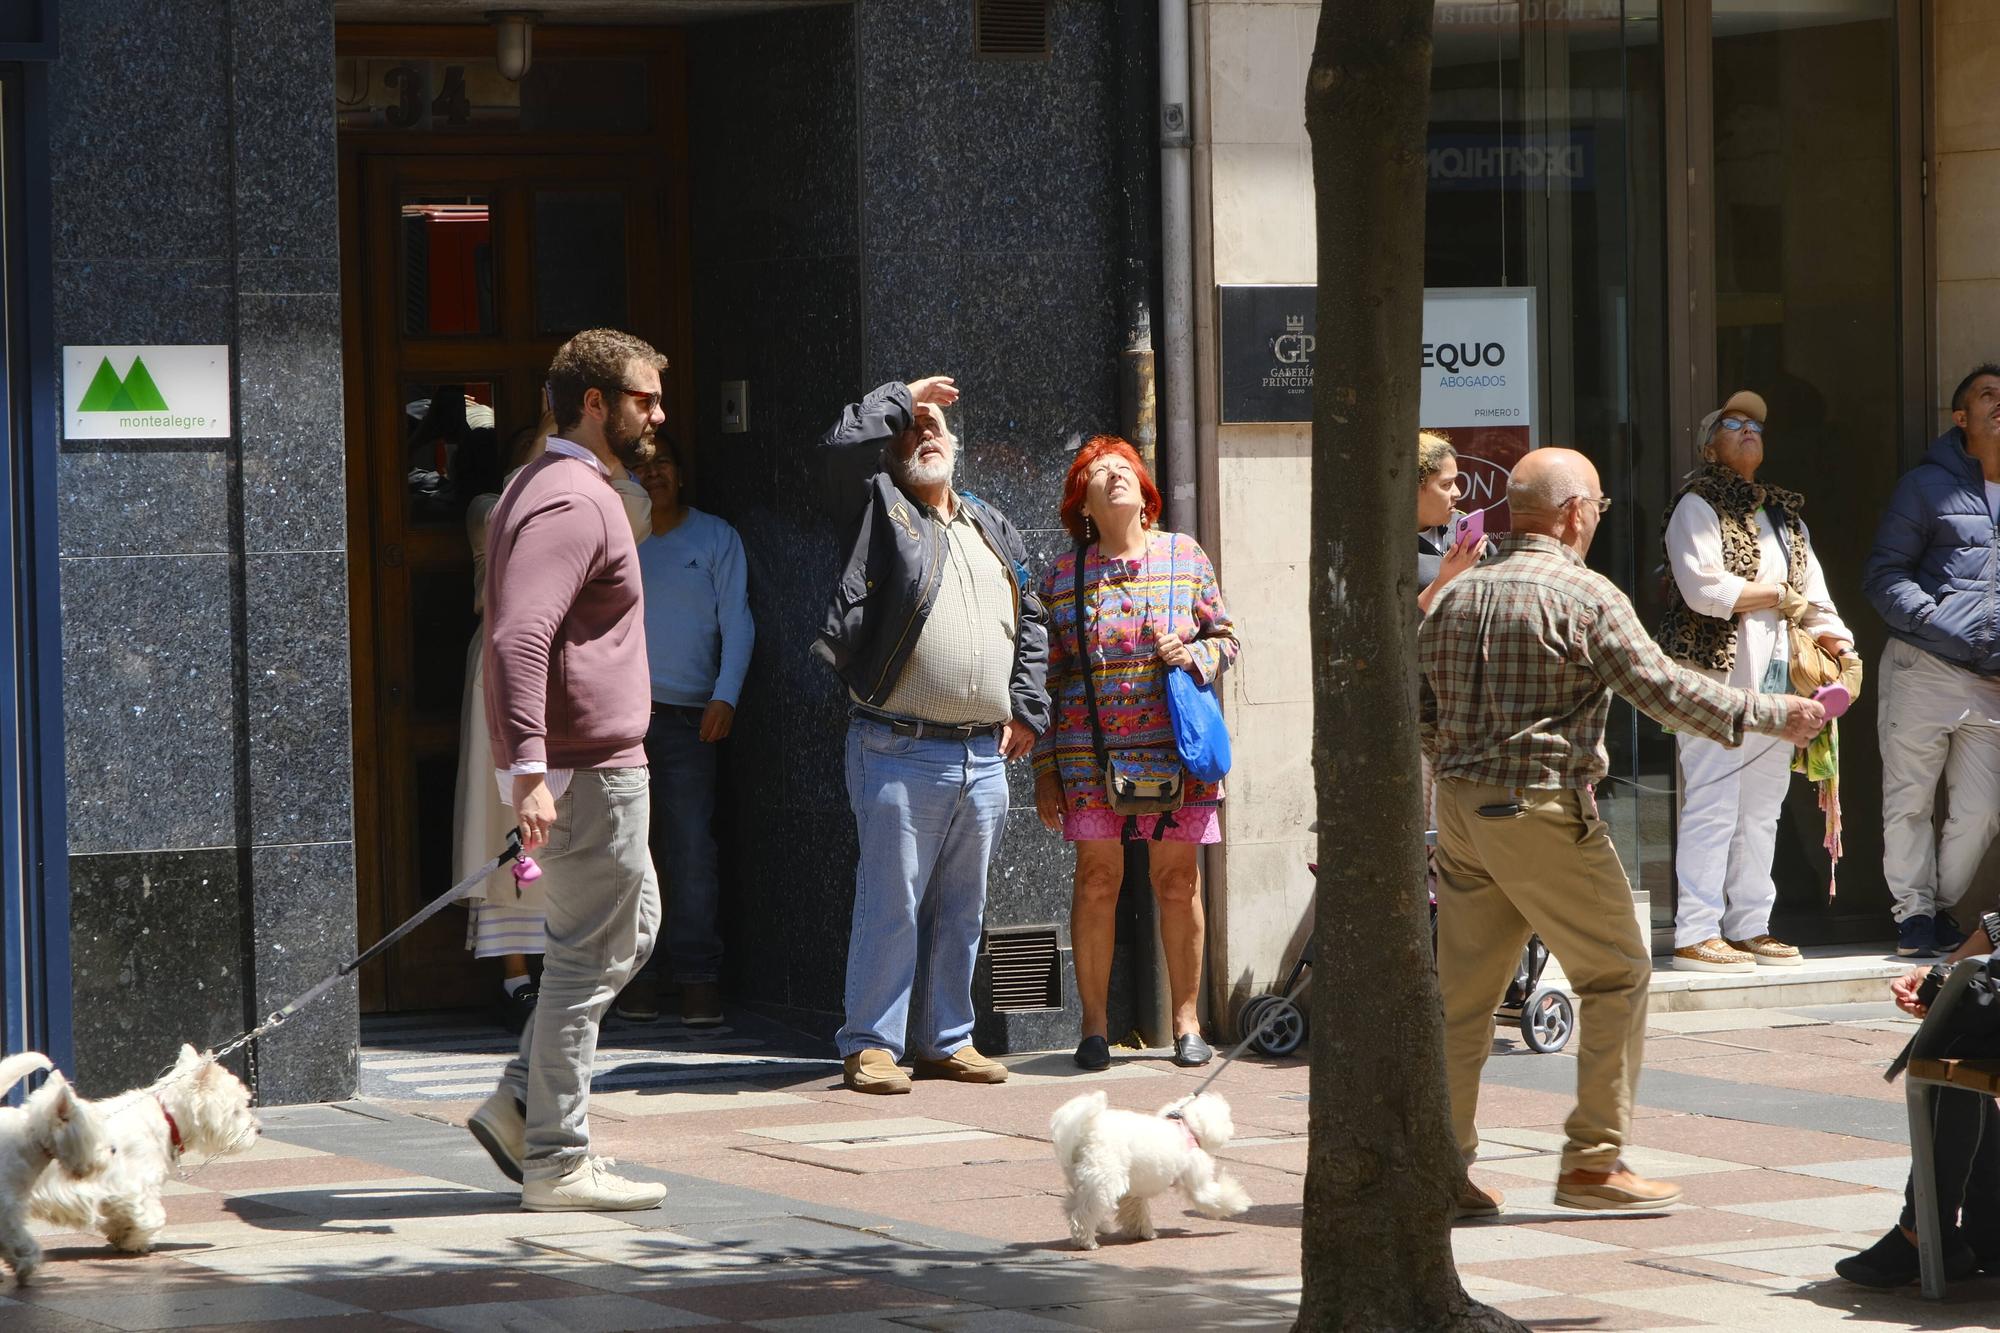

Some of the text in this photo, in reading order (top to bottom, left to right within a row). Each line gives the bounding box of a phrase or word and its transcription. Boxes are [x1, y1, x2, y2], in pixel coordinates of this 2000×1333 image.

[384, 65, 471, 128] 34
[1274, 334, 1316, 363] GP
[1440, 375, 1506, 387] ABOGADOS
[1474, 409, 1520, 417] PRIMERO D
[119, 415, 206, 429] montealegre
